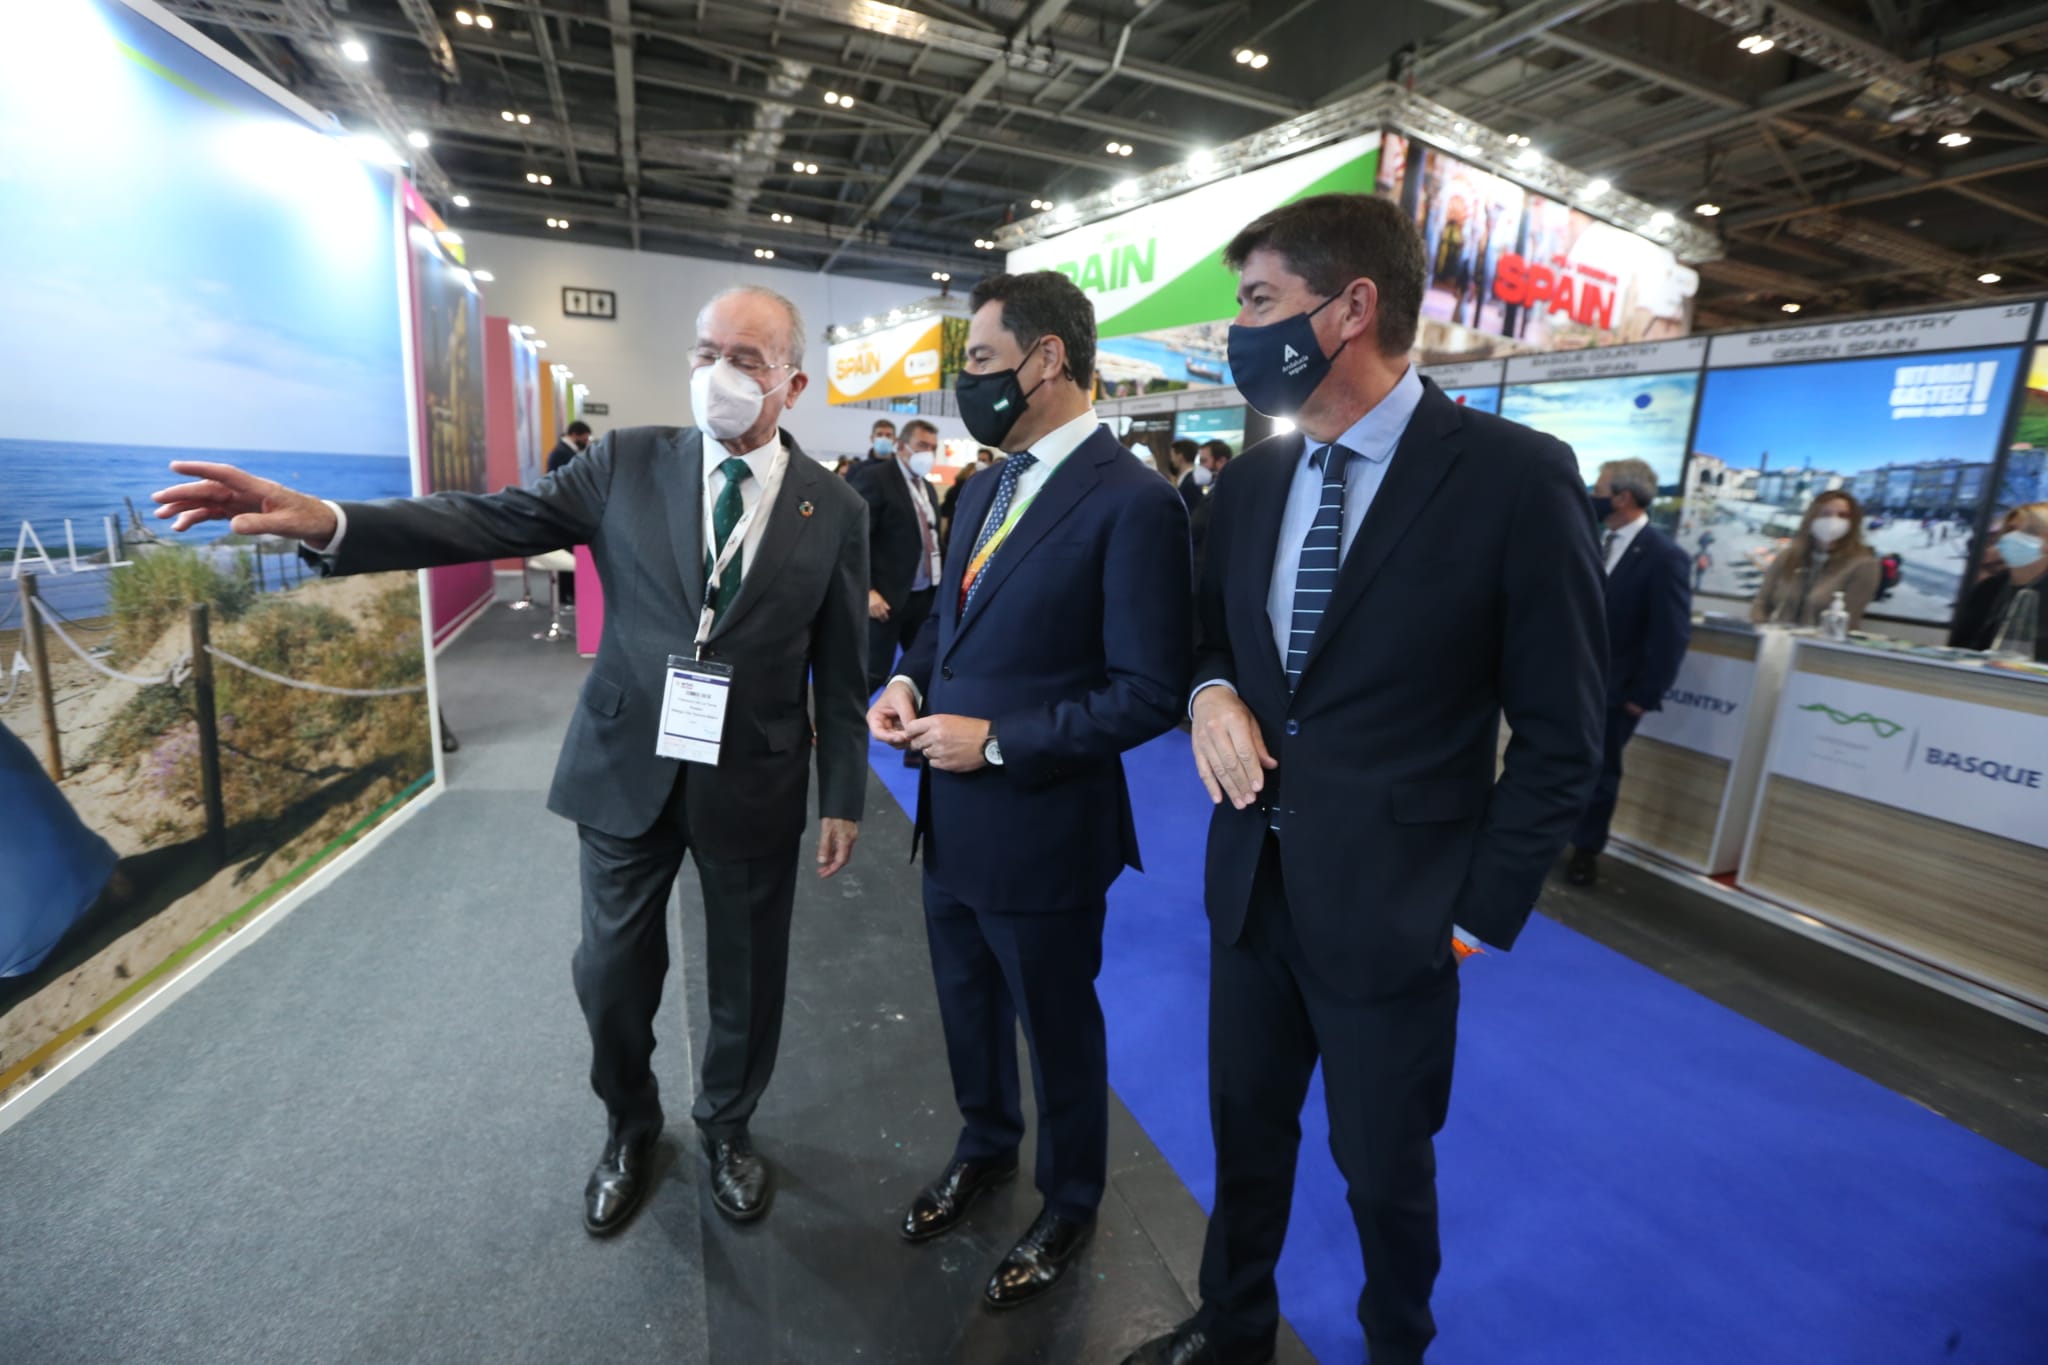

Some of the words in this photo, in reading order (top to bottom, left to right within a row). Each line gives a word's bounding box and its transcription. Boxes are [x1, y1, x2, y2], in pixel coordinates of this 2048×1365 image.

[1036, 236, 1157, 294] PAIN
[1749, 326, 1831, 347] BASQUE
[1839, 314, 1957, 338] COUNTRY
[1772, 344, 1838, 360] GREEN
[1849, 337, 1919, 356] SPAIN
[1666, 686, 1738, 716] OUNTRY
[1925, 746, 2044, 789] BASQUE
